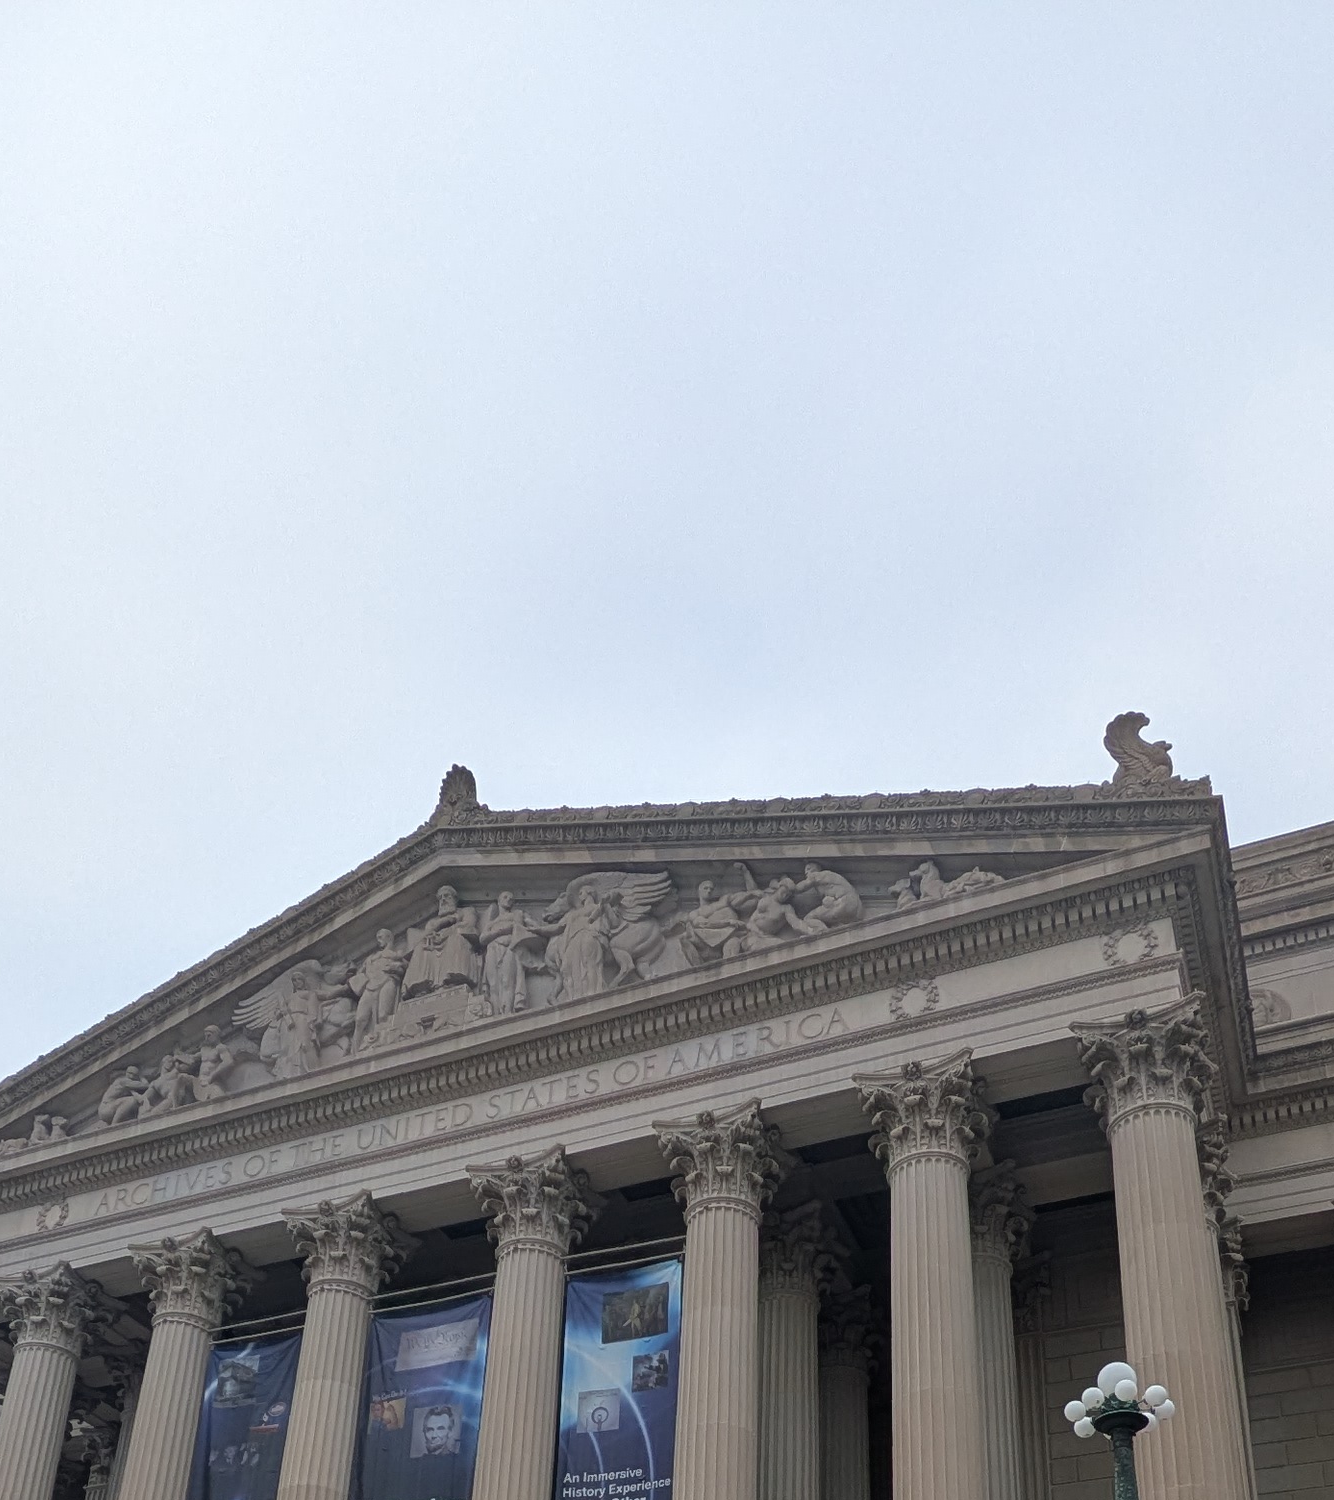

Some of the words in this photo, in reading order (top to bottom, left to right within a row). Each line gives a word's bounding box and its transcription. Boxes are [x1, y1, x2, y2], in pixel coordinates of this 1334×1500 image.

[93, 1161, 233, 1217] ARCHIVES
[243, 1148, 283, 1178] OF
[288, 1134, 344, 1168] THE
[356, 1102, 474, 1151] UNITED
[485, 1069, 600, 1119] STATES
[613, 1054, 658, 1086] OF
[665, 1007, 851, 1076] AMERICA
[563, 1472, 580, 1484] An
[582, 1467, 643, 1483] Immersive
[562, 1486, 606, 1499] History
[608, 1477, 671, 1496] Experience
